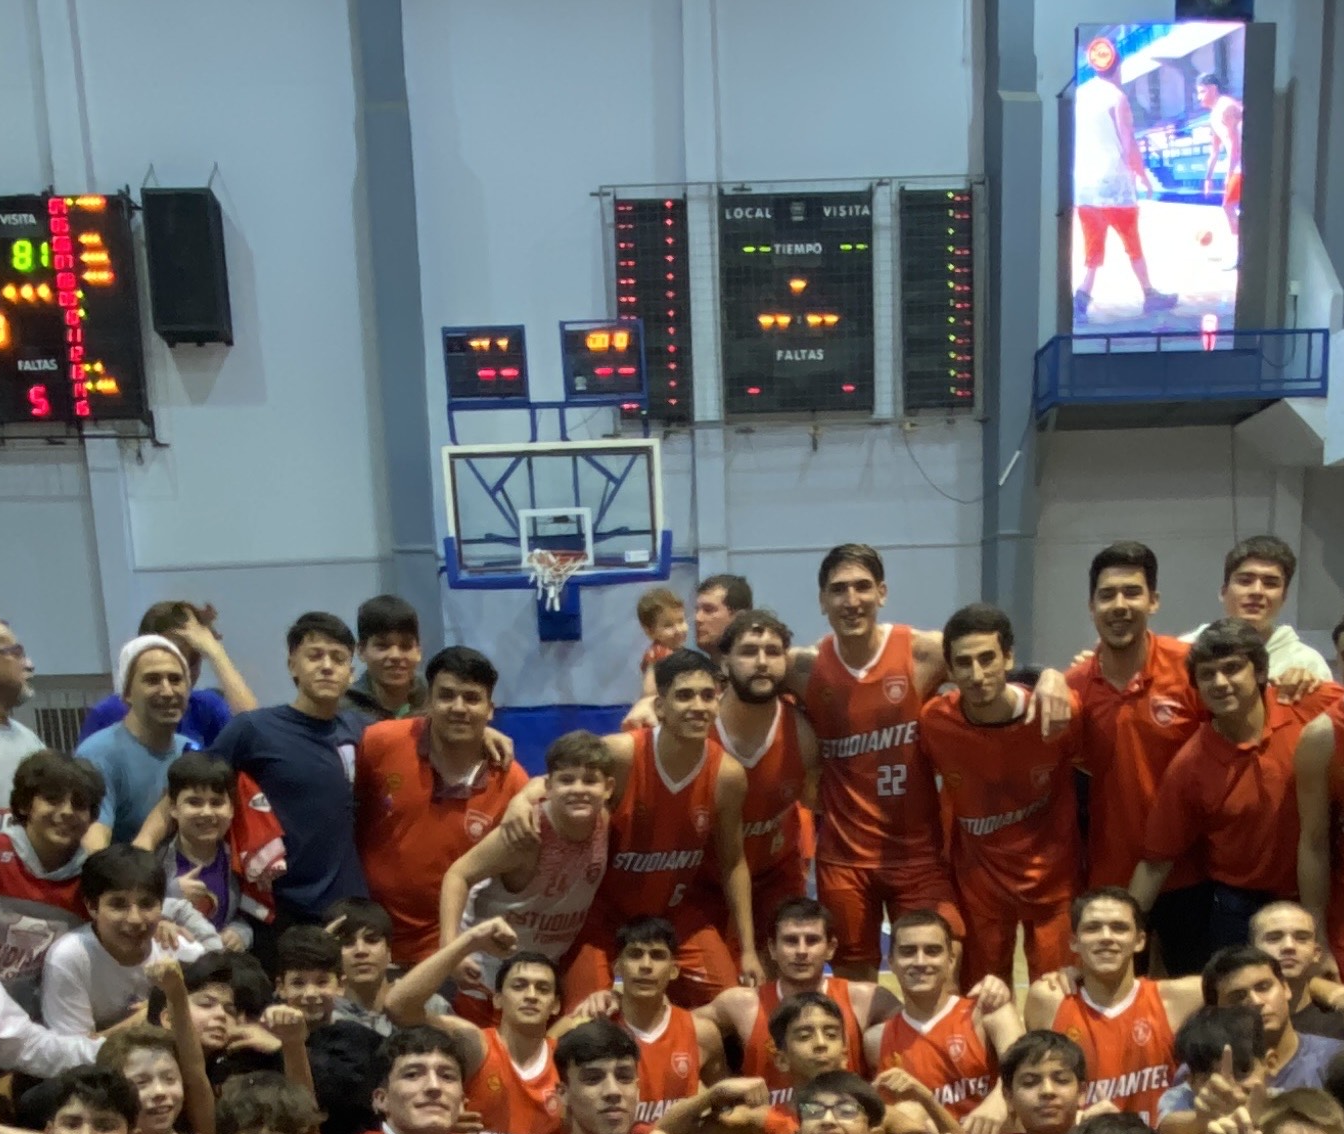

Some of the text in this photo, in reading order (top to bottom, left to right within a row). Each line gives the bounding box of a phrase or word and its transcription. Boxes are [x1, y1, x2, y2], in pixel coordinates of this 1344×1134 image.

[725, 207, 773, 221] LOCAL
[823, 204, 871, 218] VISITA
[0, 213, 37, 226] VISITA
[12, 239, 50, 271] 81
[773, 242, 822, 256] TIEMPO
[776, 348, 824, 362] FALTAS
[17, 359, 57, 371] FALTAS
[28, 384, 51, 418] 5
[877, 764, 907, 796] 22
